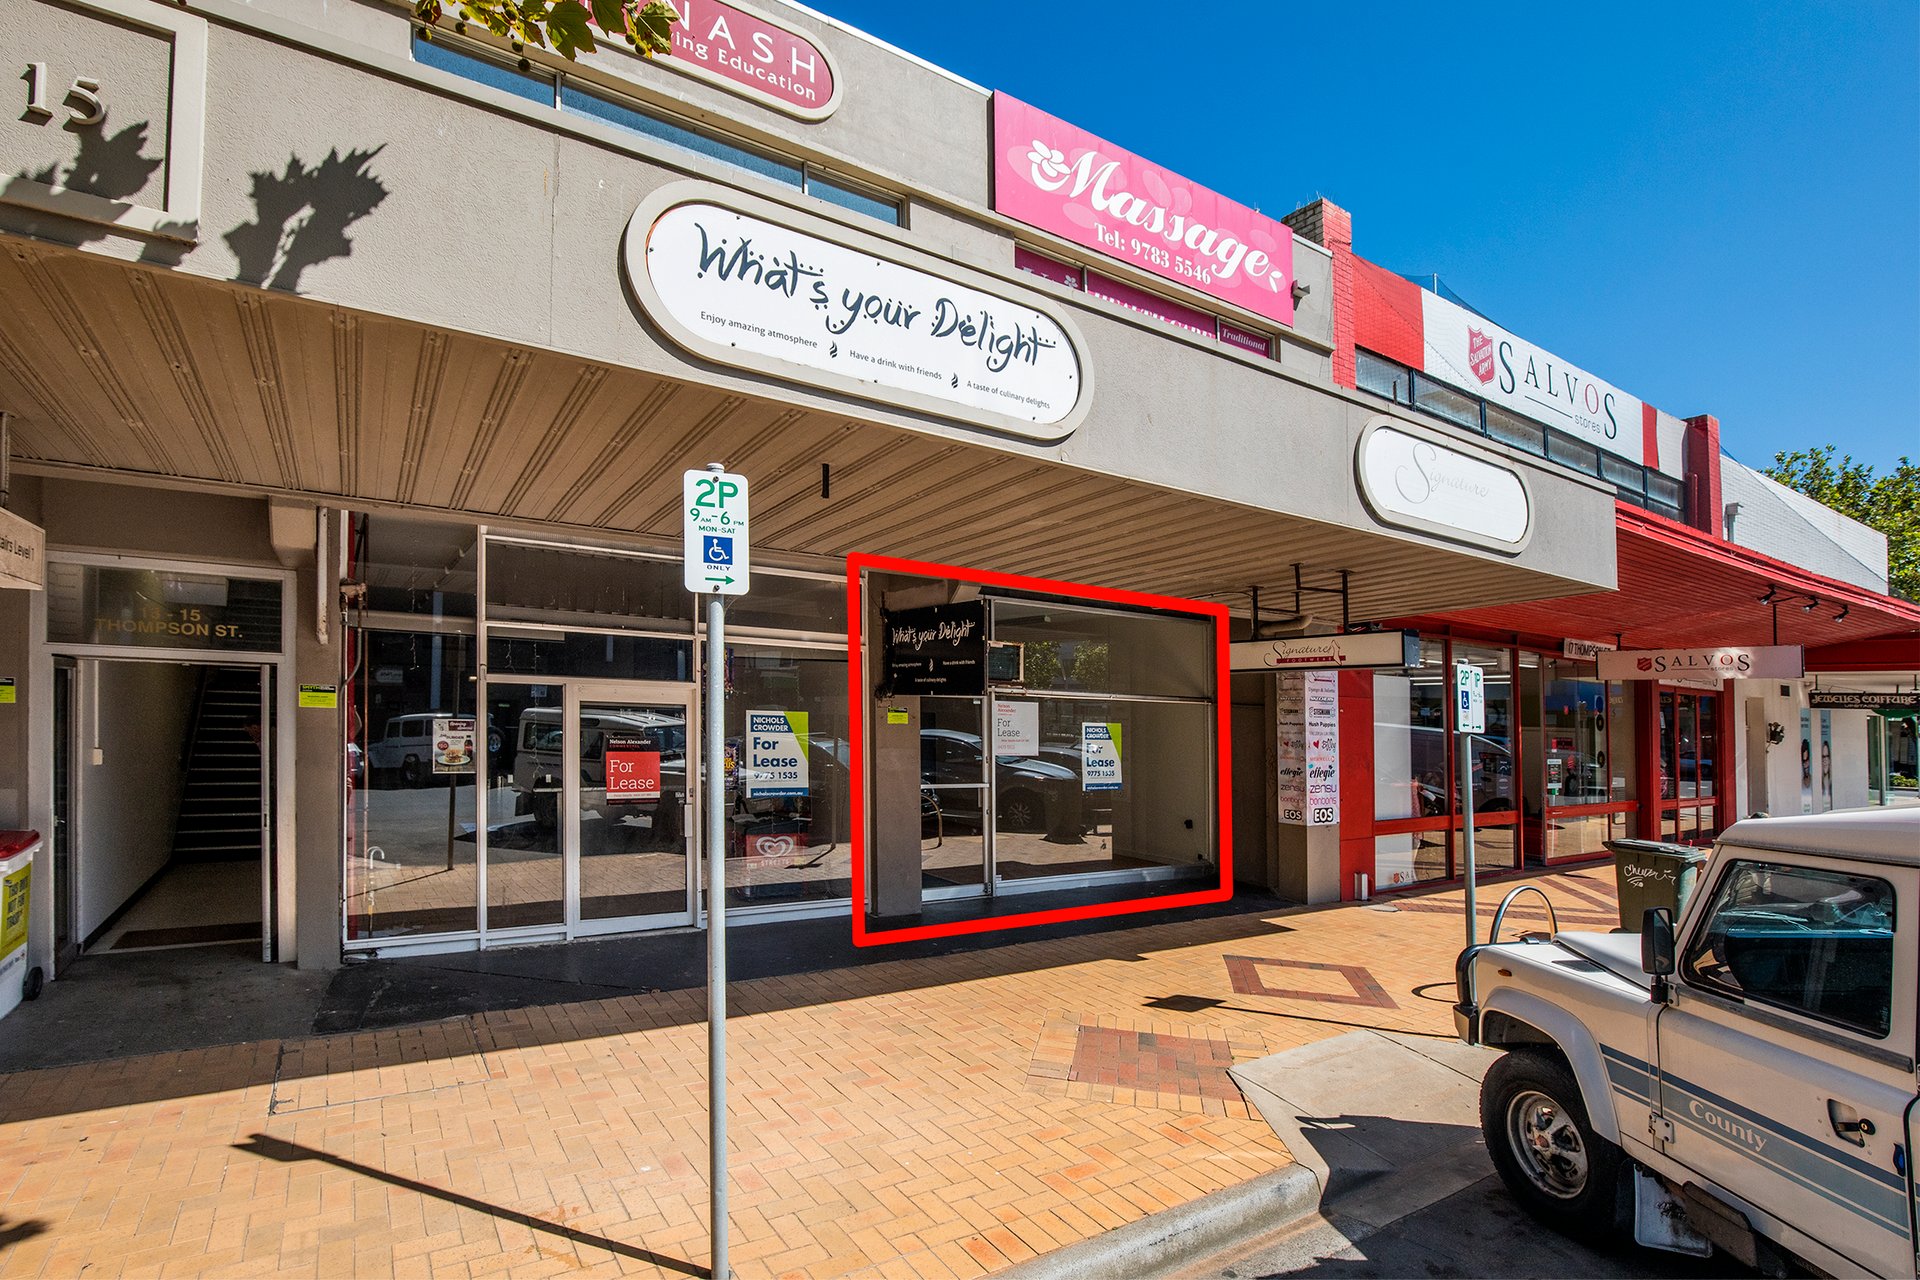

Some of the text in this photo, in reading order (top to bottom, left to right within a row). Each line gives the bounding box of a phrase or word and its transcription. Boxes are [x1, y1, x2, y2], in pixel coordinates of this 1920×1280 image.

[717, 50, 817, 102] Education
[19, 61, 105, 126] 15
[1028, 139, 1270, 279] Massage
[1094, 221, 1212, 286] Tel: 9783 5546
[700, 311, 818, 349] Enjoy amazing atmosphere
[825, 288, 921, 335] your
[931, 297, 1057, 373] Delight
[1221, 327, 1267, 352] Traditional
[850, 349, 942, 380] Have a drink with friends
[967, 380, 1051, 410] A taste of culinary delights
[1499, 340, 1617, 440] SALVOS
[1574, 414, 1601, 433] stores
[695, 479, 739, 508] 2P
[180, 608, 201, 621] 15
[95, 618, 243, 638] THOMPSON ST.
[938, 619, 976, 647] Delight
[1655, 654, 1750, 672] SALVOS
[1460, 669, 1470, 686] 2P
[1862, 694, 1917, 705] COIFFURE
[753, 724, 789, 732] CROWDER
[997, 718, 1011, 727] For
[997, 728, 1021, 737] Lease
[753, 736, 779, 750] For
[609, 759, 635, 773] For
[753, 753, 798, 768] Lease
[1086, 756, 1115, 768] Lease
[609, 776, 655, 790] Lease
[778, 771, 798, 780] 1535
[1284, 810, 1302, 820] EOS
[1314, 808, 1333, 823] EOS
[1688, 1099, 1767, 1152] County
